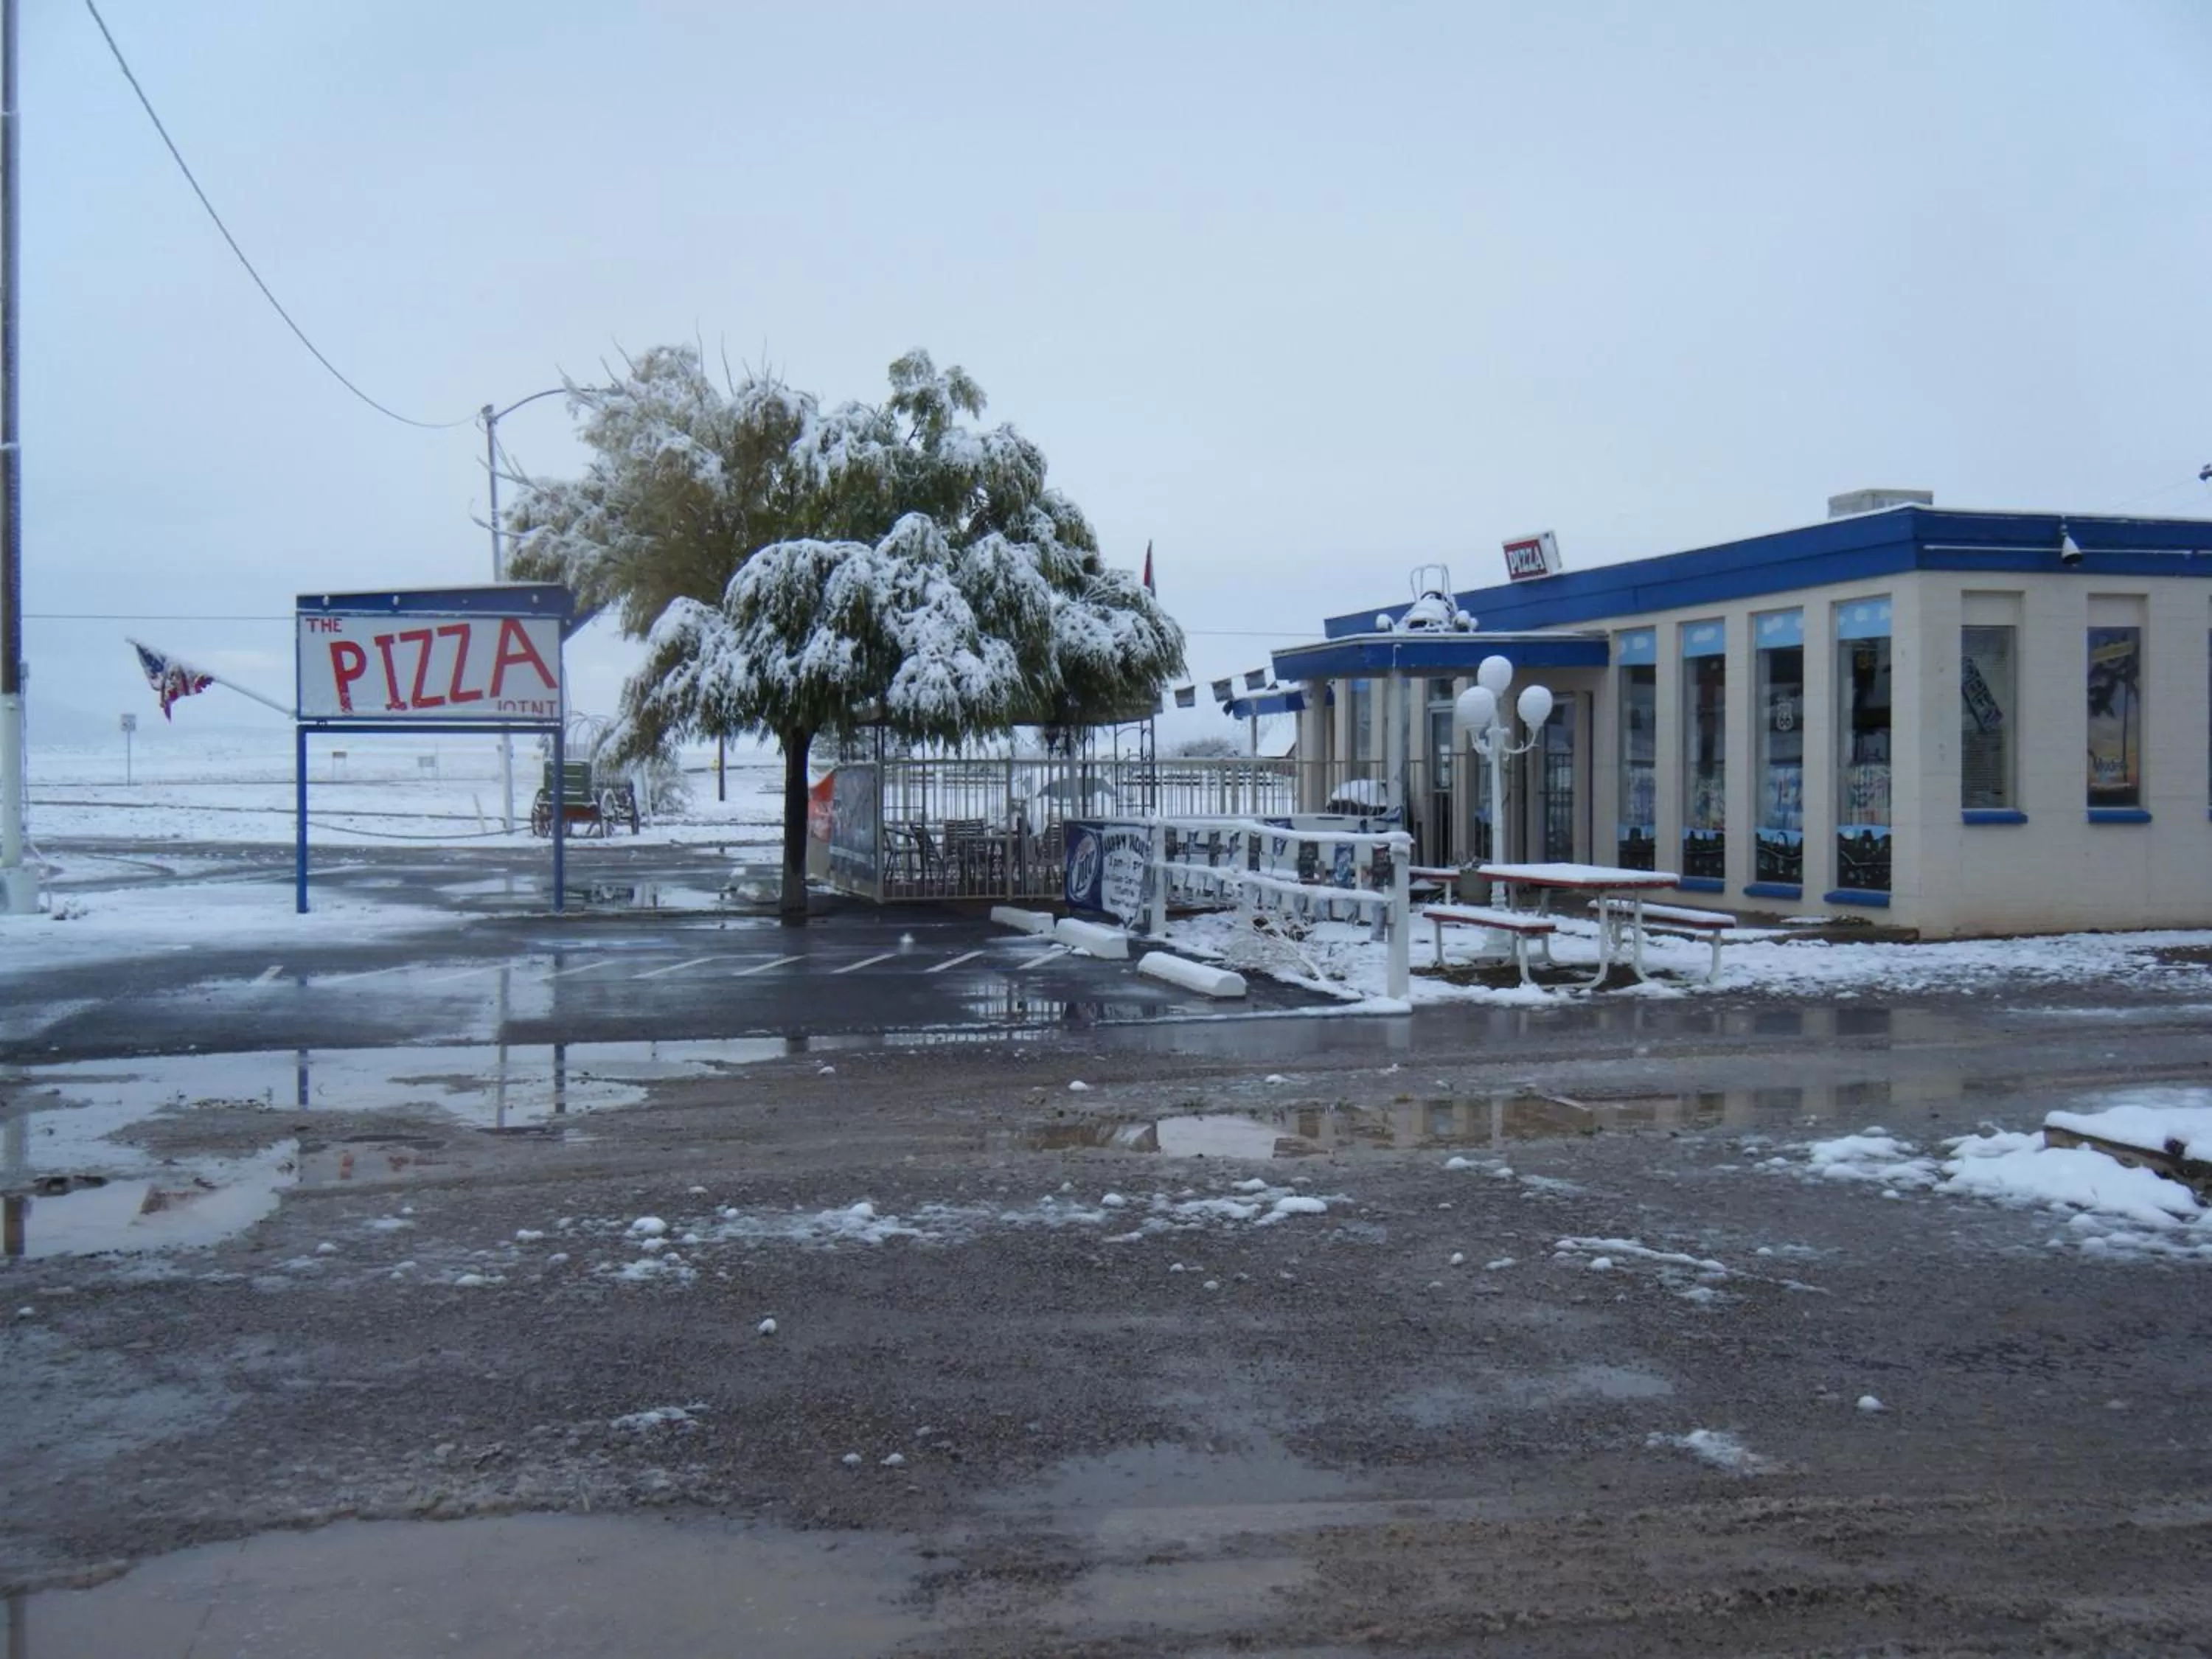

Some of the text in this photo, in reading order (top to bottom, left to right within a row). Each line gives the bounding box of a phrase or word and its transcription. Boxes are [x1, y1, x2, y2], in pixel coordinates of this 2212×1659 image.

[1506, 546, 1546, 574] PIZZA
[306, 617, 343, 633] THE
[329, 617, 558, 714] PIZZA
